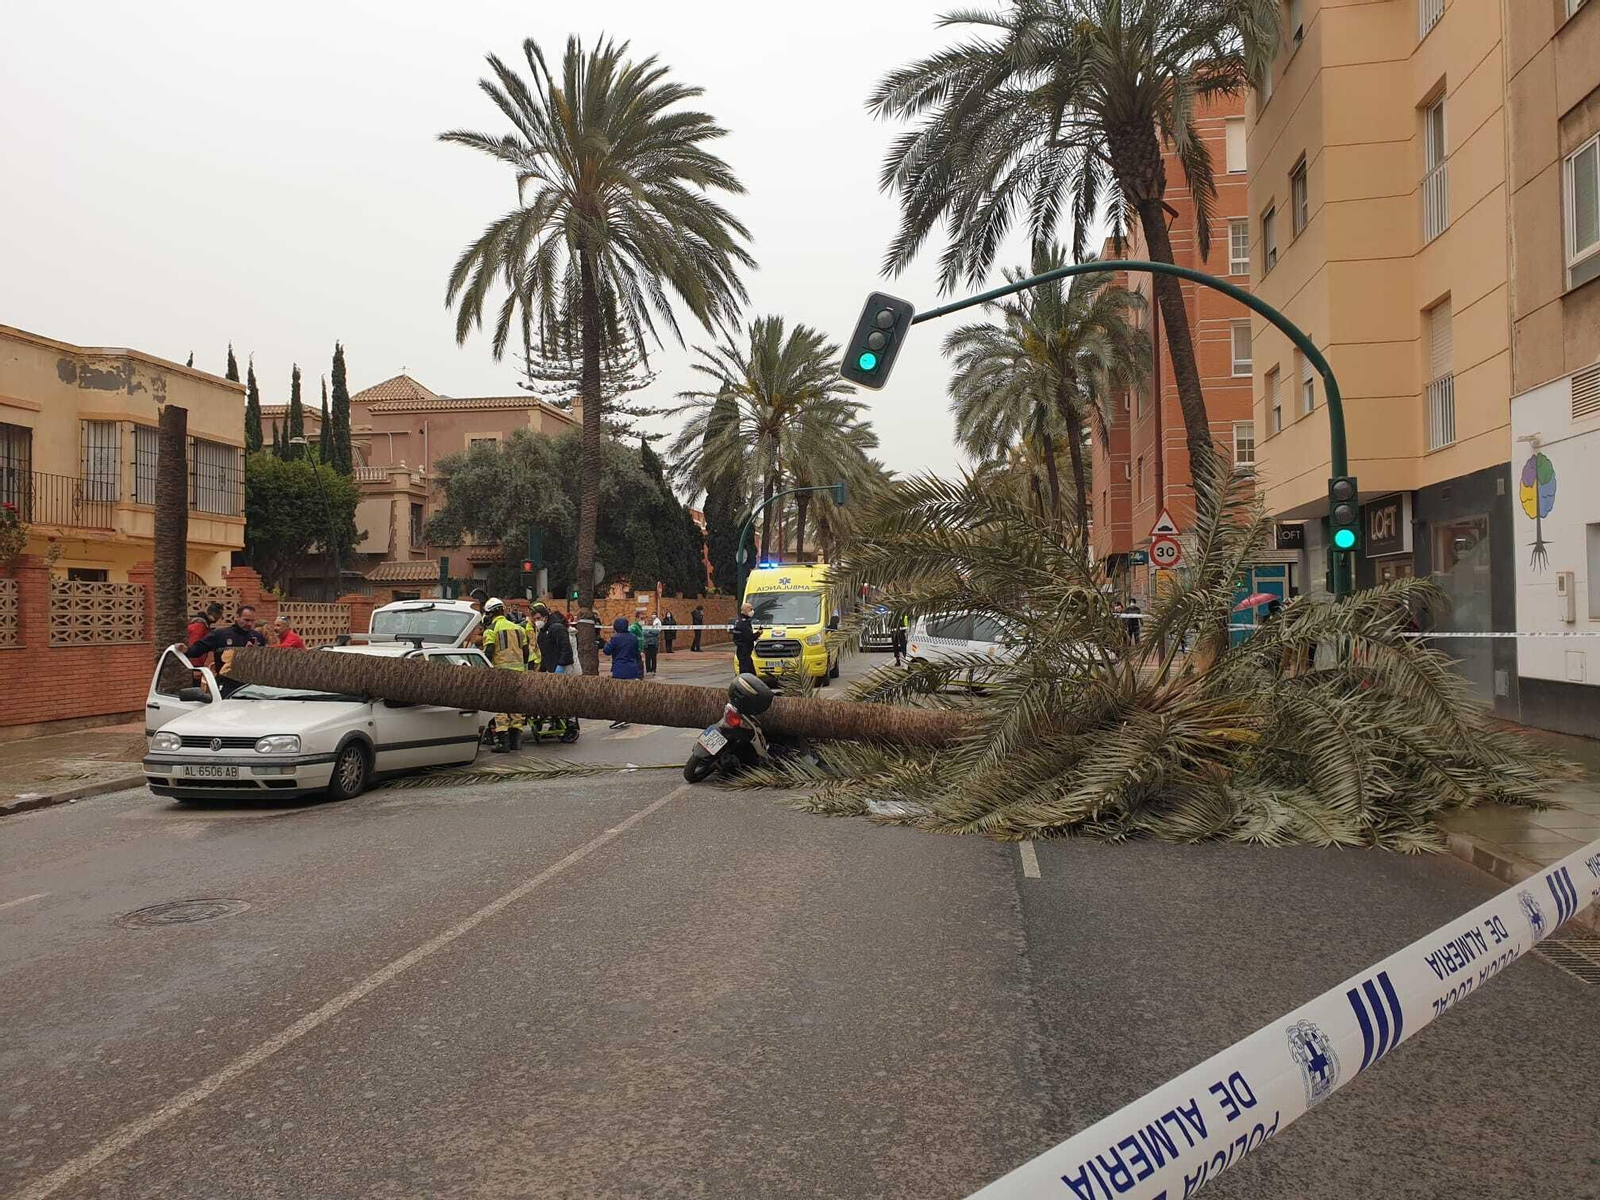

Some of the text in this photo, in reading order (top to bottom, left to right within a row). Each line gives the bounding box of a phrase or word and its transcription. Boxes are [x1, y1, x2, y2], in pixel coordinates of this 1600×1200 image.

[1278, 530, 1301, 541] LOFT
[1371, 505, 1397, 540] LOFT
[1156, 546, 1175, 558] 30
[1424, 915, 1509, 981] DE ALMERIA
[1060, 1070, 1258, 1200] DE ALMERIA
[1183, 1111, 1280, 1200] POLICIA
